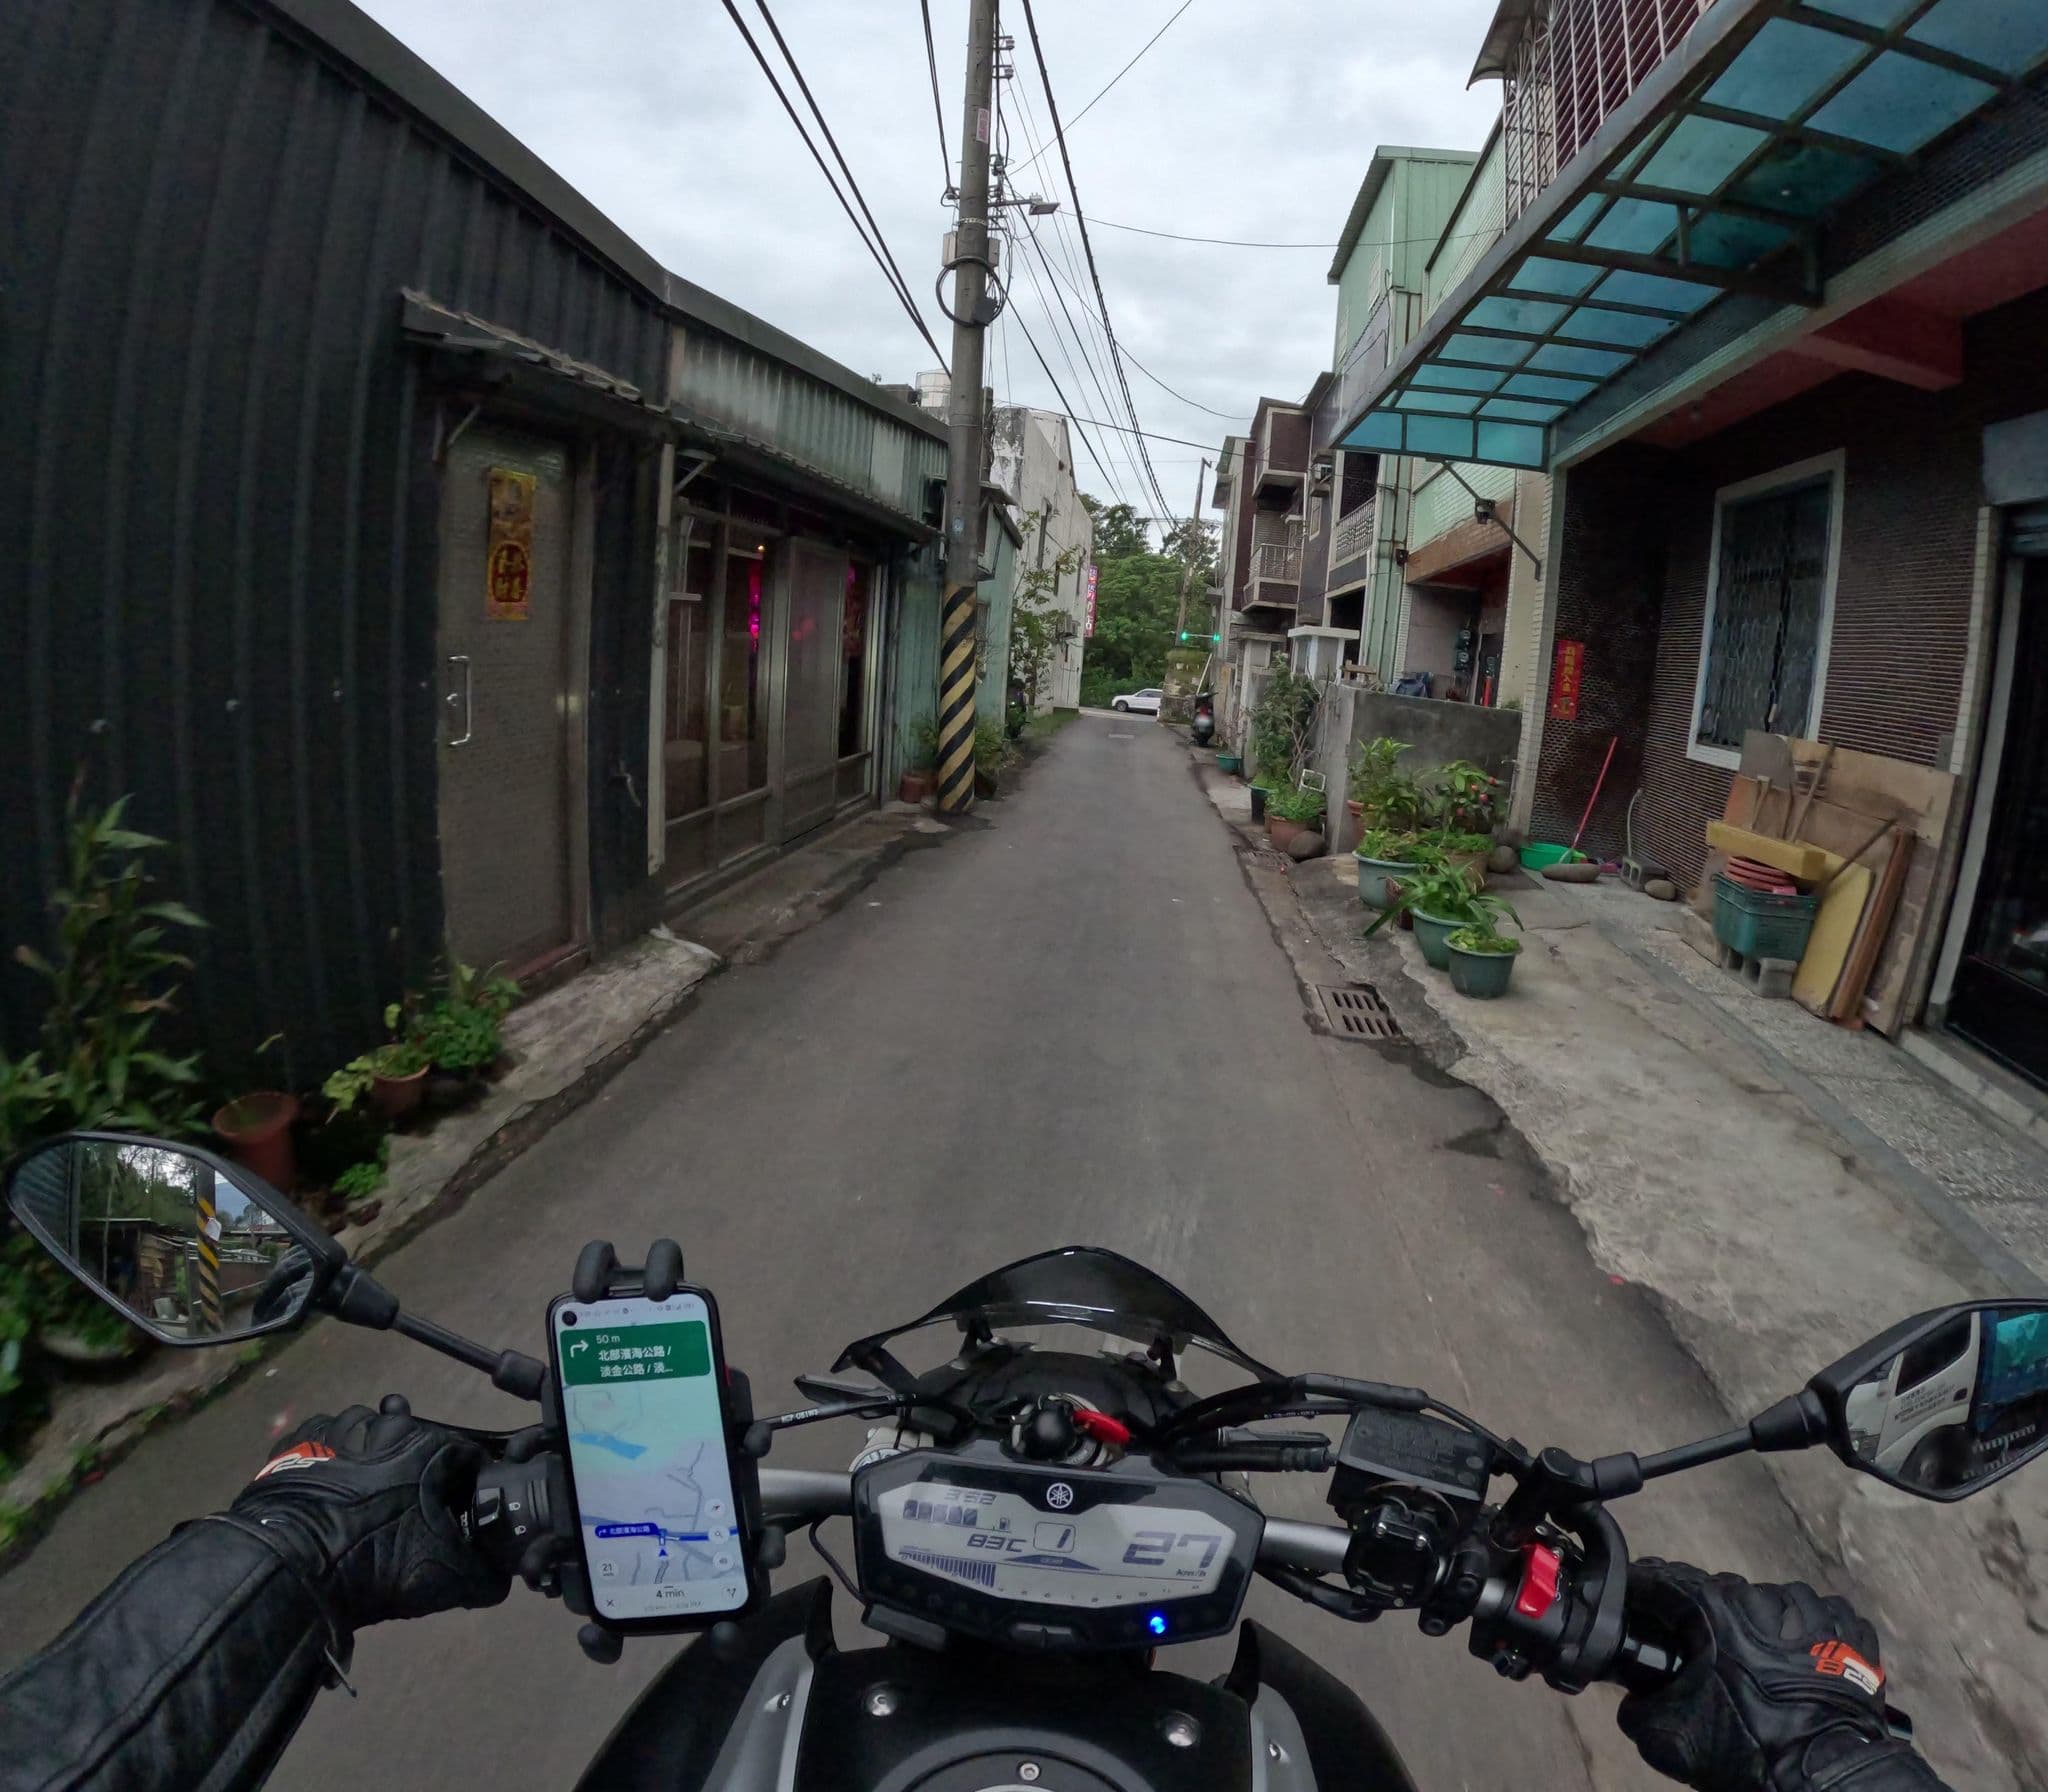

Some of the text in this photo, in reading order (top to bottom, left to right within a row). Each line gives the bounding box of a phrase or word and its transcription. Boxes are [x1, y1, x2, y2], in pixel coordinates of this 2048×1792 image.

[595, 1334, 609, 1344] 50
[1122, 1531, 1222, 1569] 27
[656, 1588, 684, 1598] 4 min
